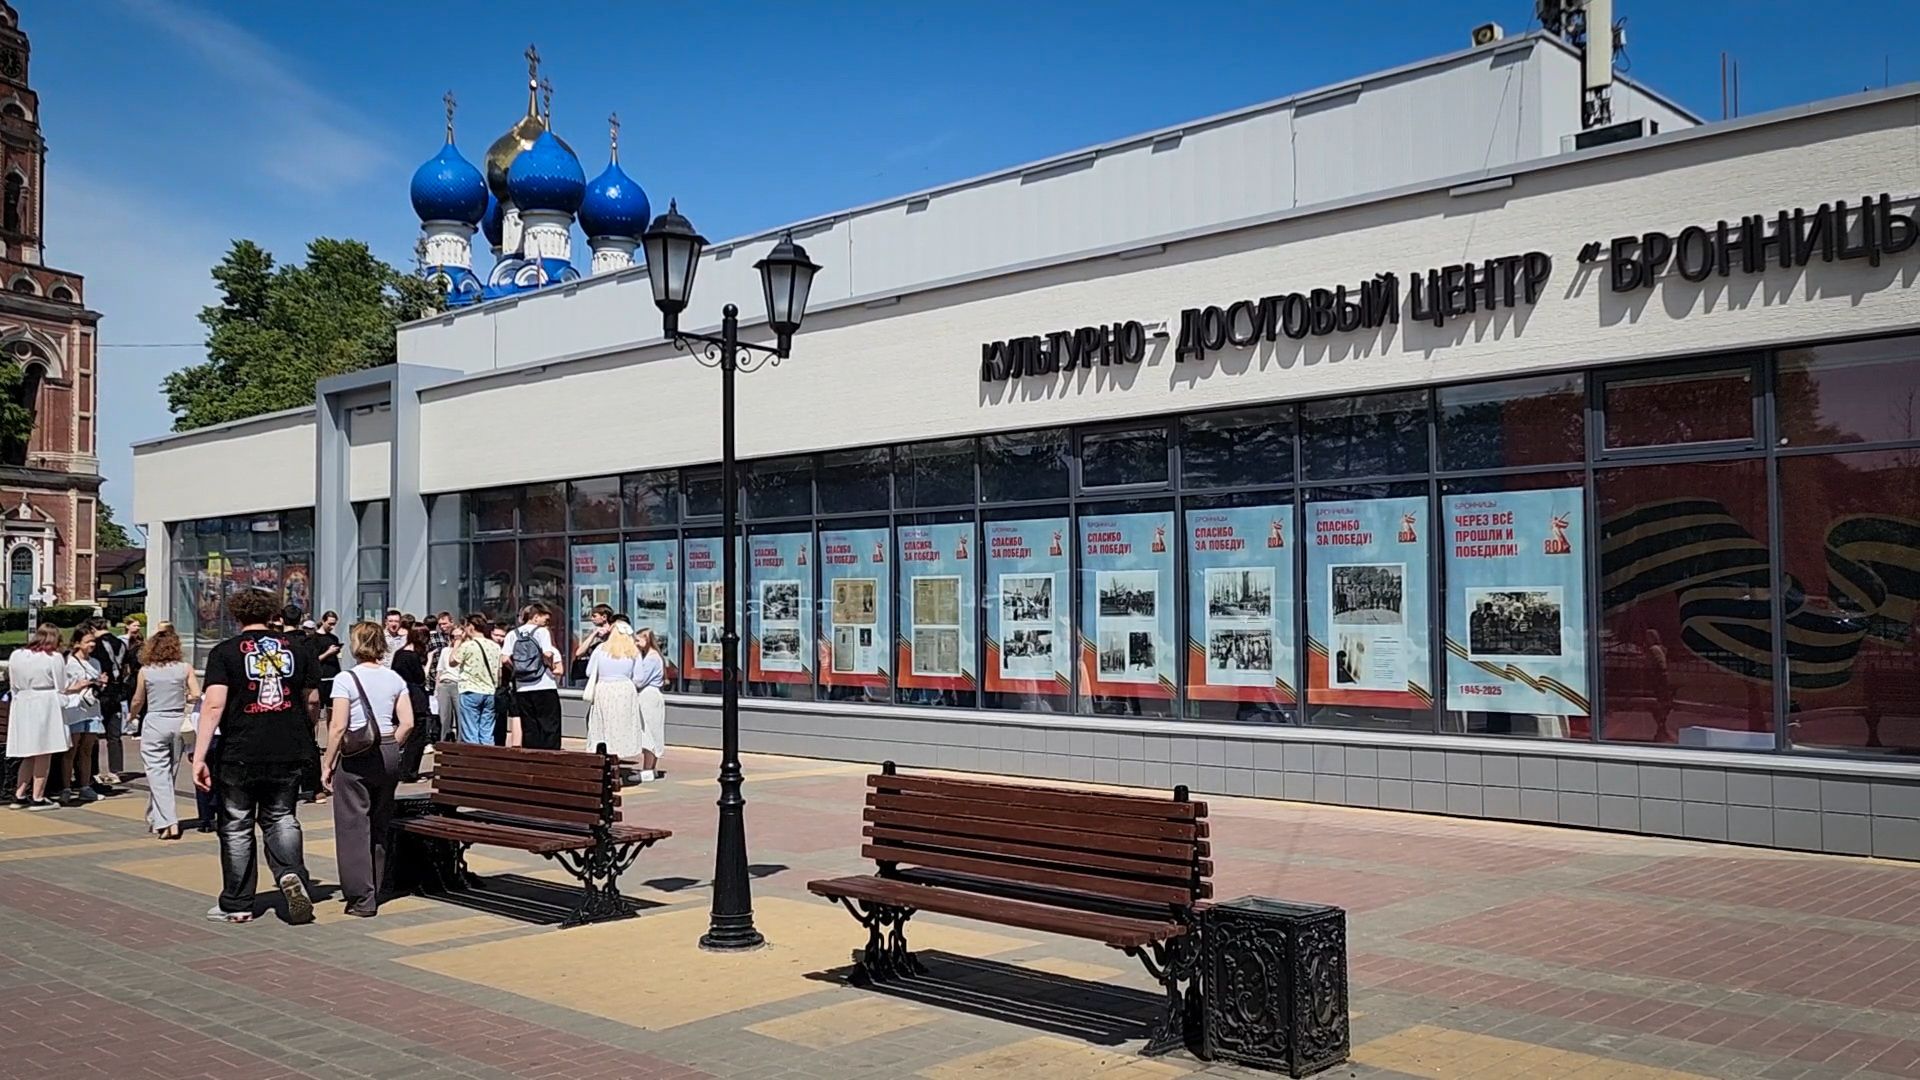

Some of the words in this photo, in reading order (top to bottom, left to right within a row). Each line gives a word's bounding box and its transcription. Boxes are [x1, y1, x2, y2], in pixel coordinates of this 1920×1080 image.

[1410, 252, 1553, 327] ЦЕНТР
[1455, 513, 1489, 527] ЧЕРЕЗ
[1492, 511, 1513, 526] ВСЁ
[1195, 526, 1234, 538] СПАСИБО
[1316, 519, 1360, 533] СПАСИБО
[1087, 532, 1122, 542] СПАСИБО
[1316, 533, 1330, 545] ЗА
[1331, 532, 1373, 546] ПОБЕДУ!
[1455, 529, 1503, 542] ПРОШЛИ
[1506, 528, 1513, 540] И
[904, 540, 932, 550] СПАСИБО
[991, 536, 1023, 547] СПАСИБО
[1195, 540, 1206, 551] ЗА
[1209, 539, 1245, 551] ПОБЕДУ!
[1544, 539, 1559, 553] 80
[991, 548, 1001, 558] ЗА
[1002, 547, 1032, 559] ПОБЕДУ!
[1087, 545, 1098, 554] ЗА
[1100, 543, 1132, 555] ПОБЕДУ!
[1455, 544, 1518, 559] ПОБЕДИЛИ!
[904, 552, 912, 562] ЗА
[1460, 685, 1503, 696] 1945-2025
